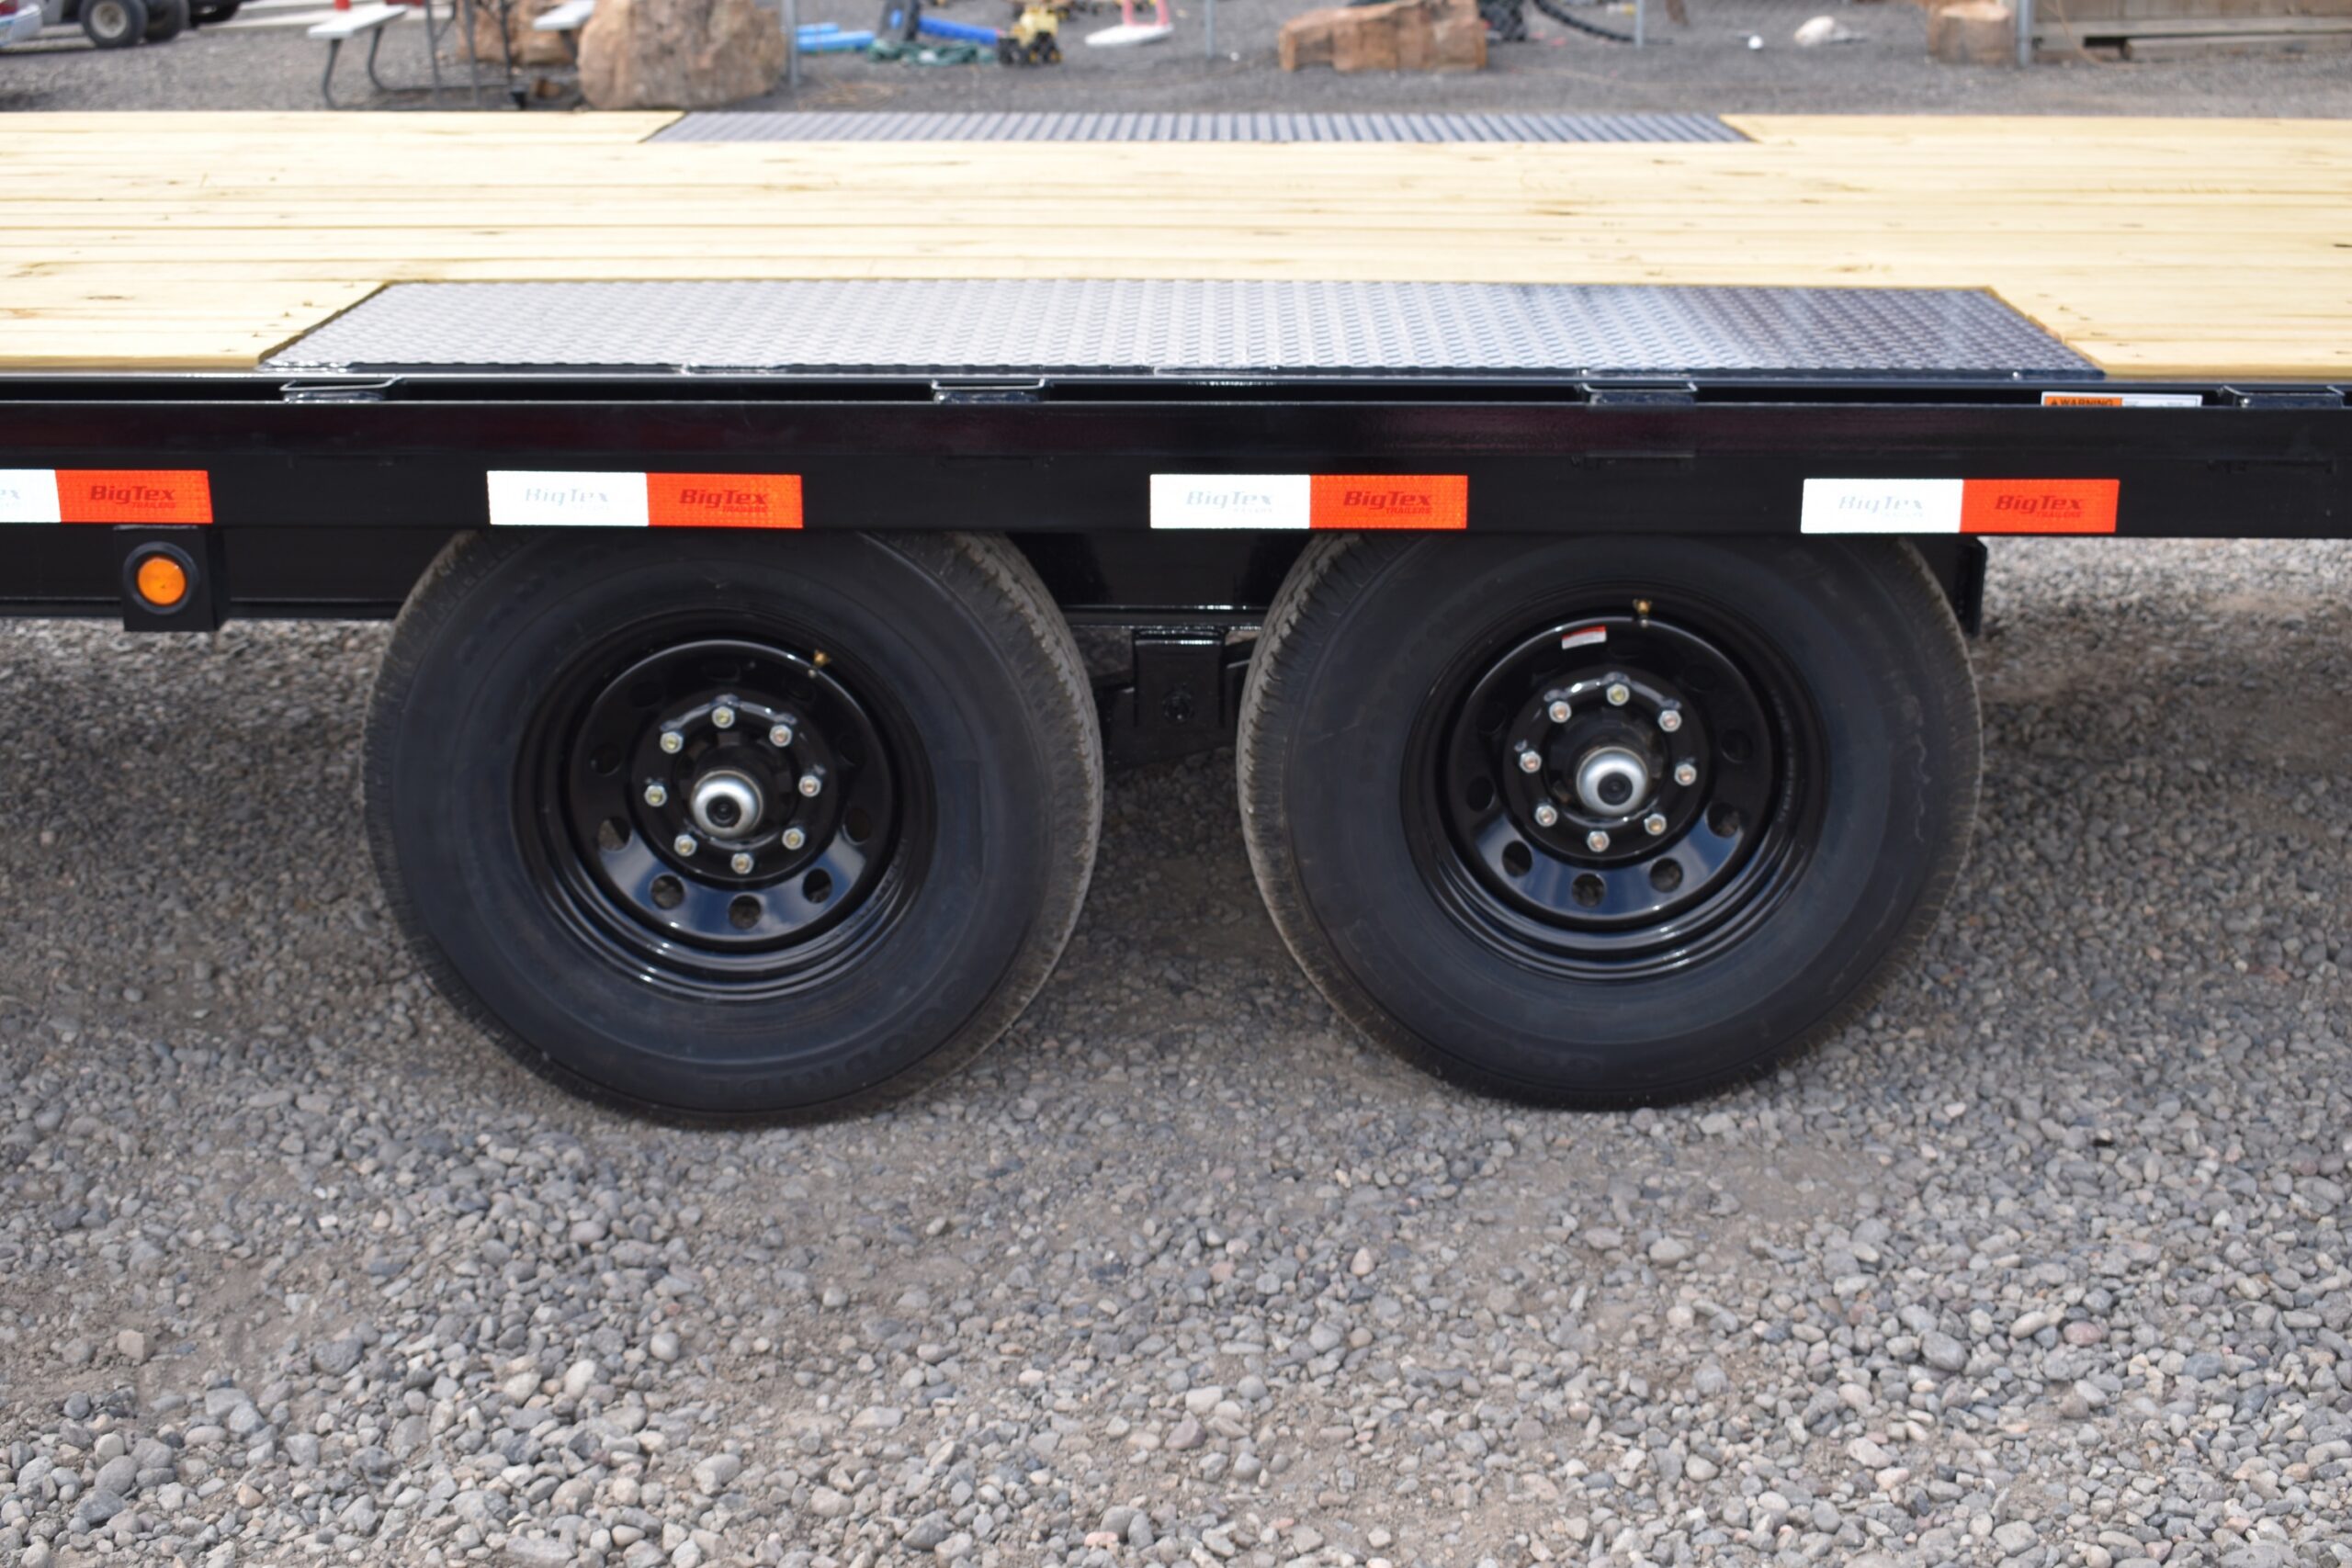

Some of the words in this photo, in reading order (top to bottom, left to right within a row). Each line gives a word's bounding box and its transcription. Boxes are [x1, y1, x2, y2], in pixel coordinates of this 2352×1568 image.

[91, 486, 175, 504] BigTex
[525, 488, 608, 506] BigTex
[680, 489, 770, 508] BigTex
[1186, 491, 1272, 509] BigTex
[1343, 491, 1432, 510] BigTex
[1995, 495, 2083, 513] BigTex
[1385, 506, 1432, 514] TRAILERS
